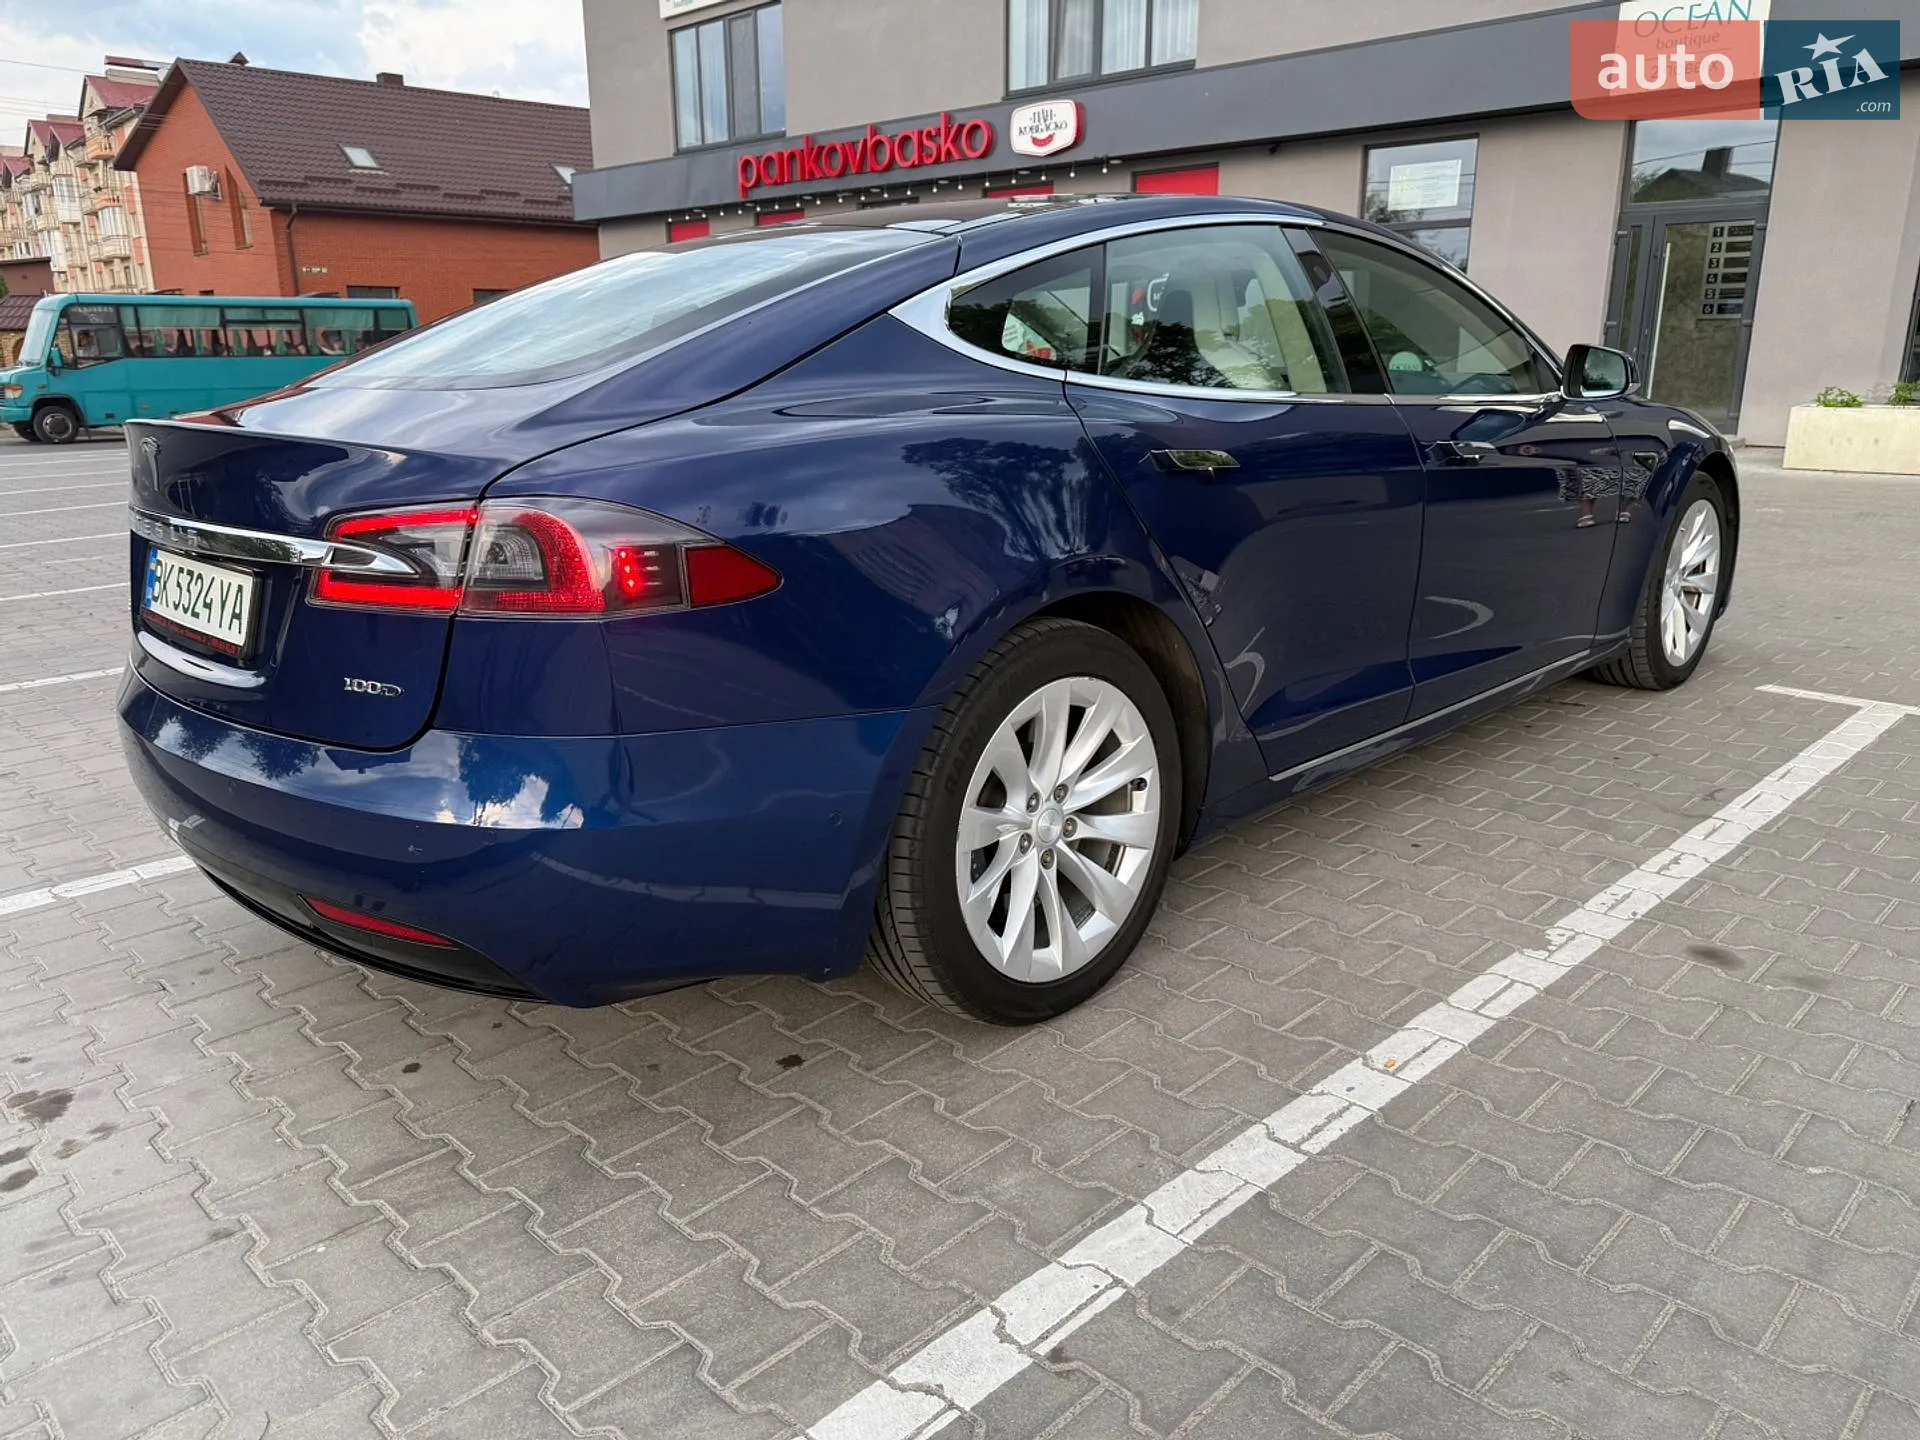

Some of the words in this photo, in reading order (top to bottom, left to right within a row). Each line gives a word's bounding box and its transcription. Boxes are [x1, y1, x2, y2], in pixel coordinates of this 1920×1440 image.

[1634, 0, 1752, 38] OCEAN
[1656, 31, 1721, 51] boutique
[738, 111, 994, 200] pankovbasko
[152, 559, 175, 608] BK
[173, 566, 215, 624] 5324
[218, 579, 244, 635] YA
[343, 677, 403, 697] 100D
